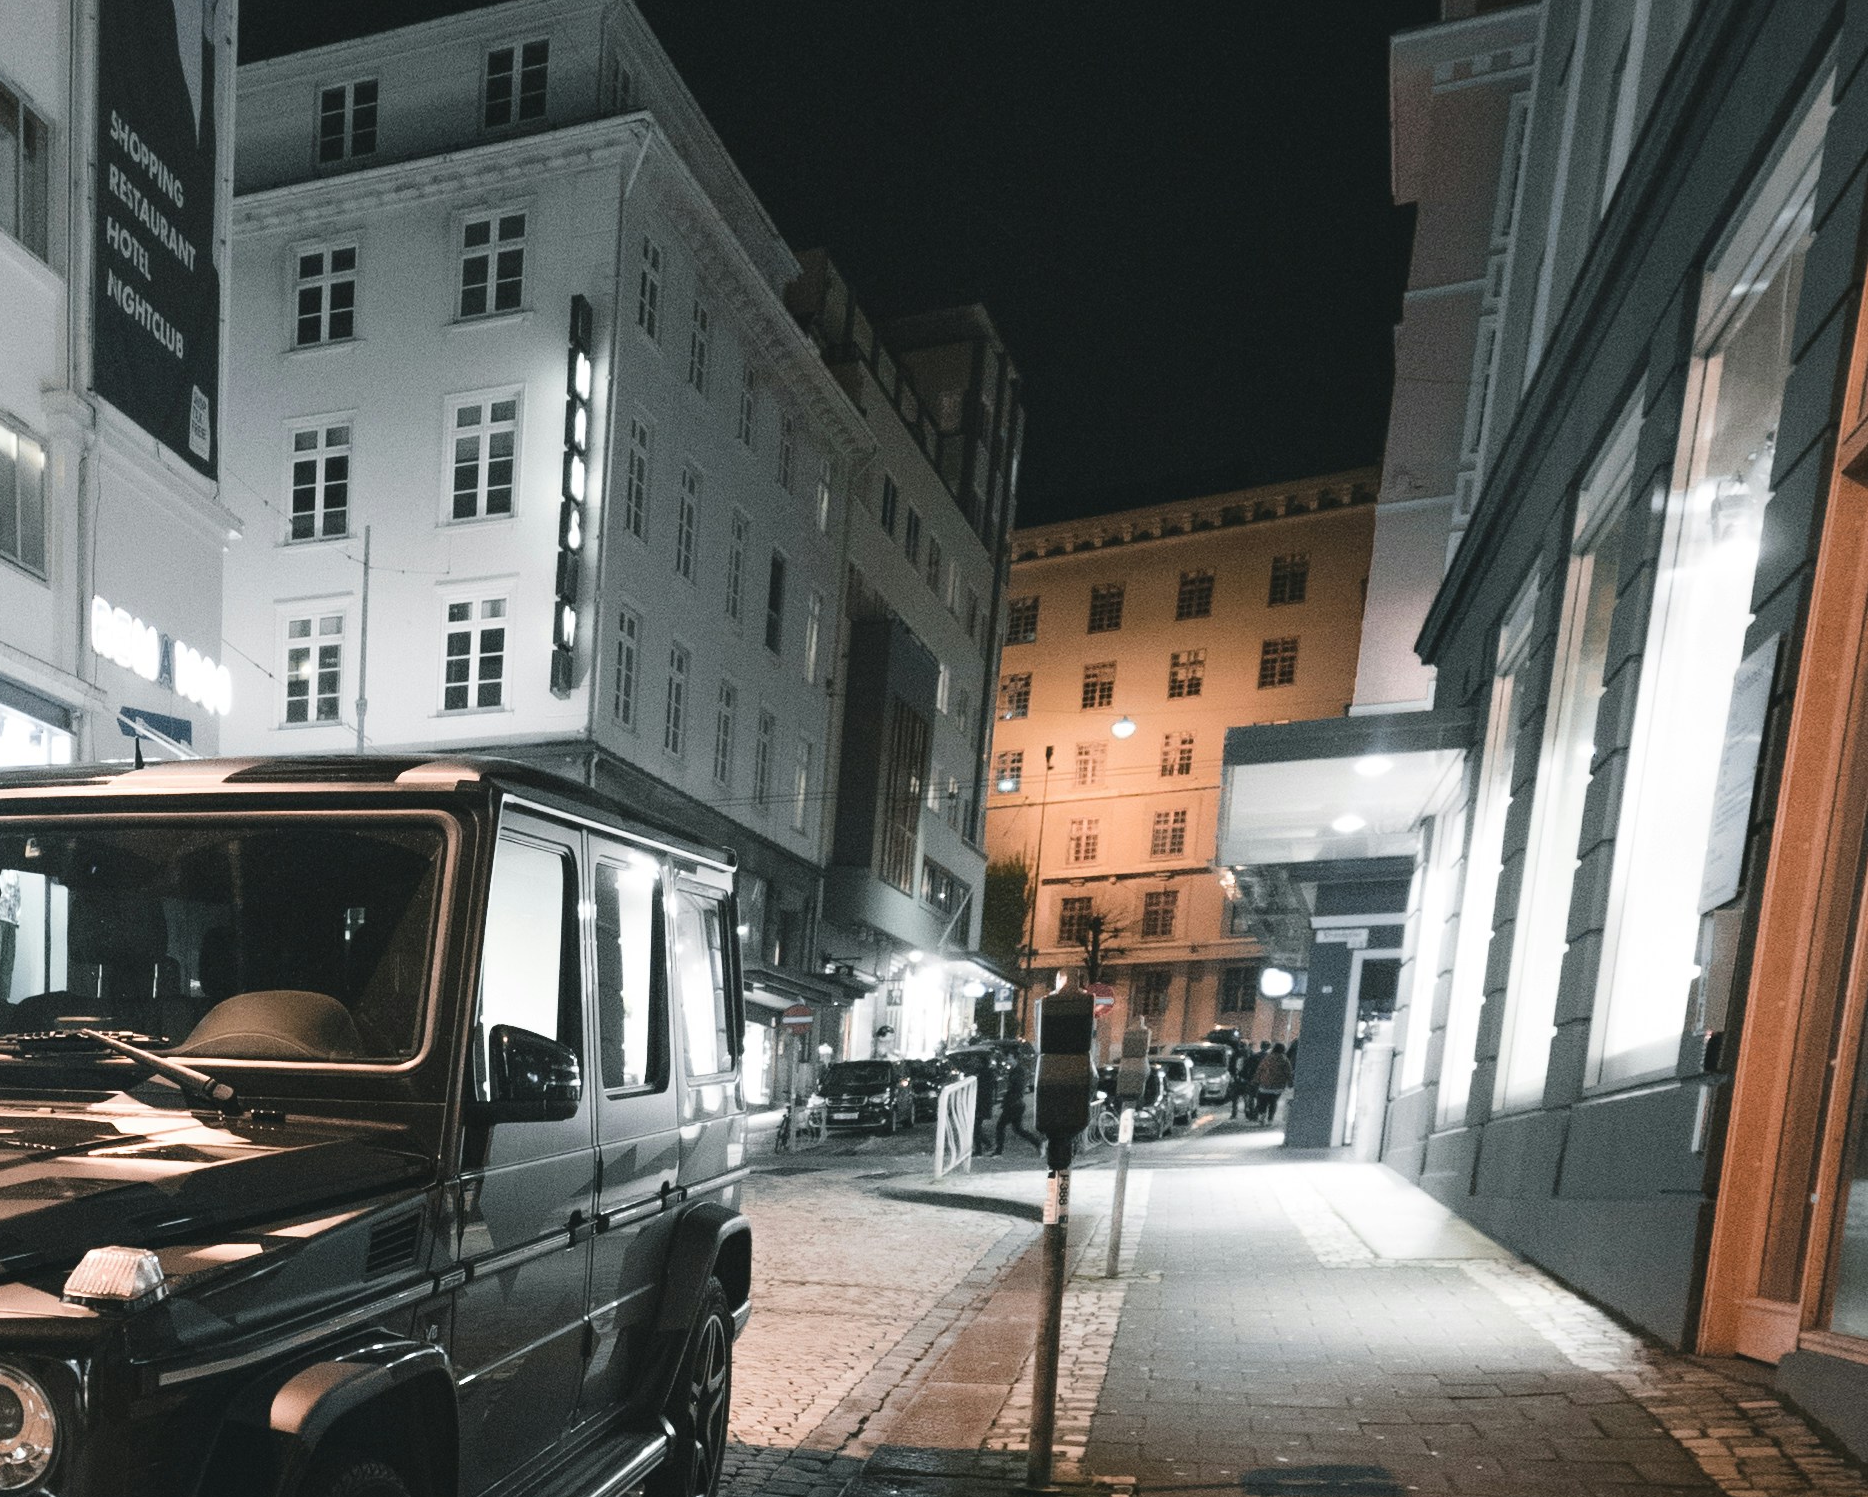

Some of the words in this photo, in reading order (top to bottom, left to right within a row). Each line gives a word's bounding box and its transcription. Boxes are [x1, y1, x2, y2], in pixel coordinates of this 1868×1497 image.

[110, 109, 184, 209] SHOPPING
[105, 215, 151, 282] HOTEL
[108, 162, 196, 273] RESTAURANT
[107, 267, 184, 360] NIGHTCLUB
